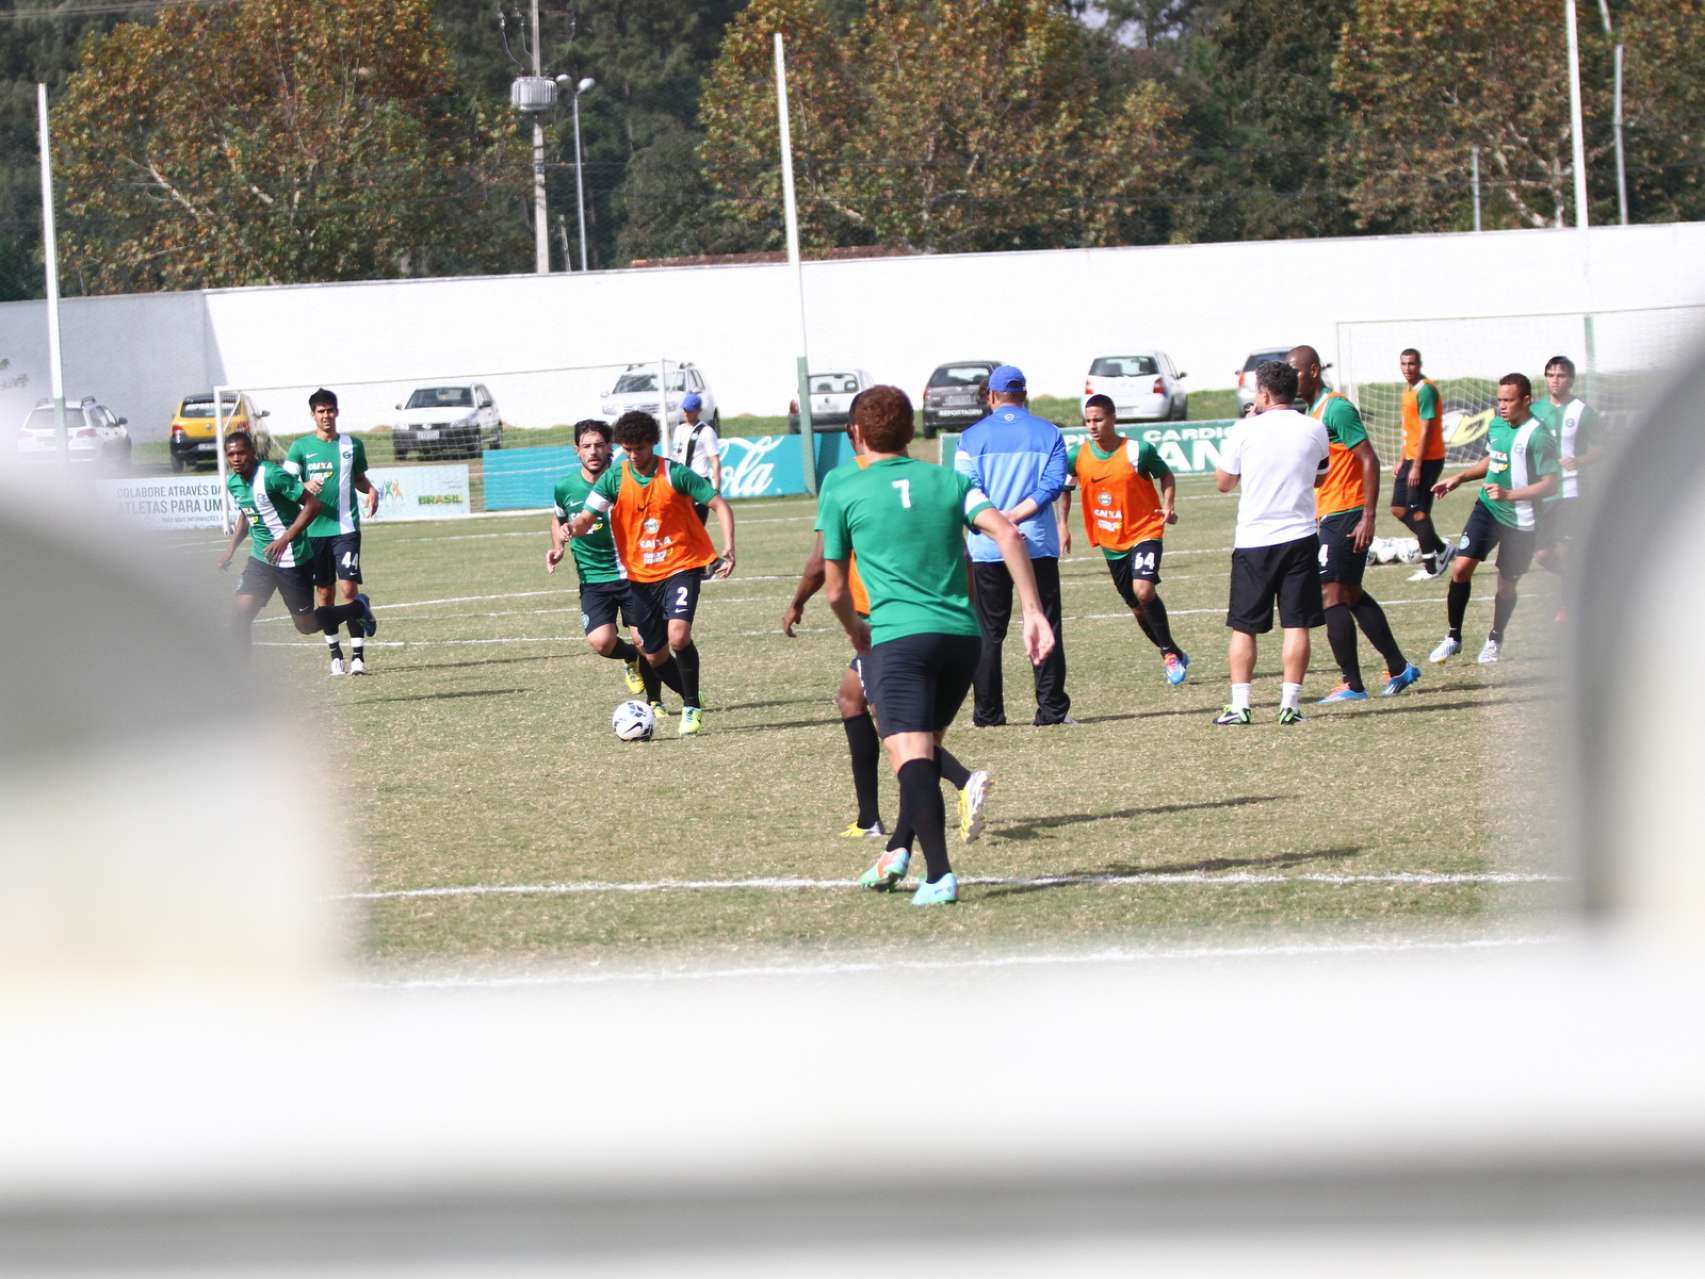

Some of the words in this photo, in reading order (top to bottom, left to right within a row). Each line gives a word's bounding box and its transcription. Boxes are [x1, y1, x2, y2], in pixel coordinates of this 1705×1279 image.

[116, 486, 167, 499] COLABORE
[168, 484, 209, 497] ATRAVÉS
[418, 494, 465, 505] BRASIL
[891, 479, 912, 509] 7
[119, 500, 168, 514] ATLETAS
[170, 500, 201, 513] PARA
[340, 551, 360, 570] 44
[1134, 551, 1155, 570] 64
[675, 586, 688, 606] 2
